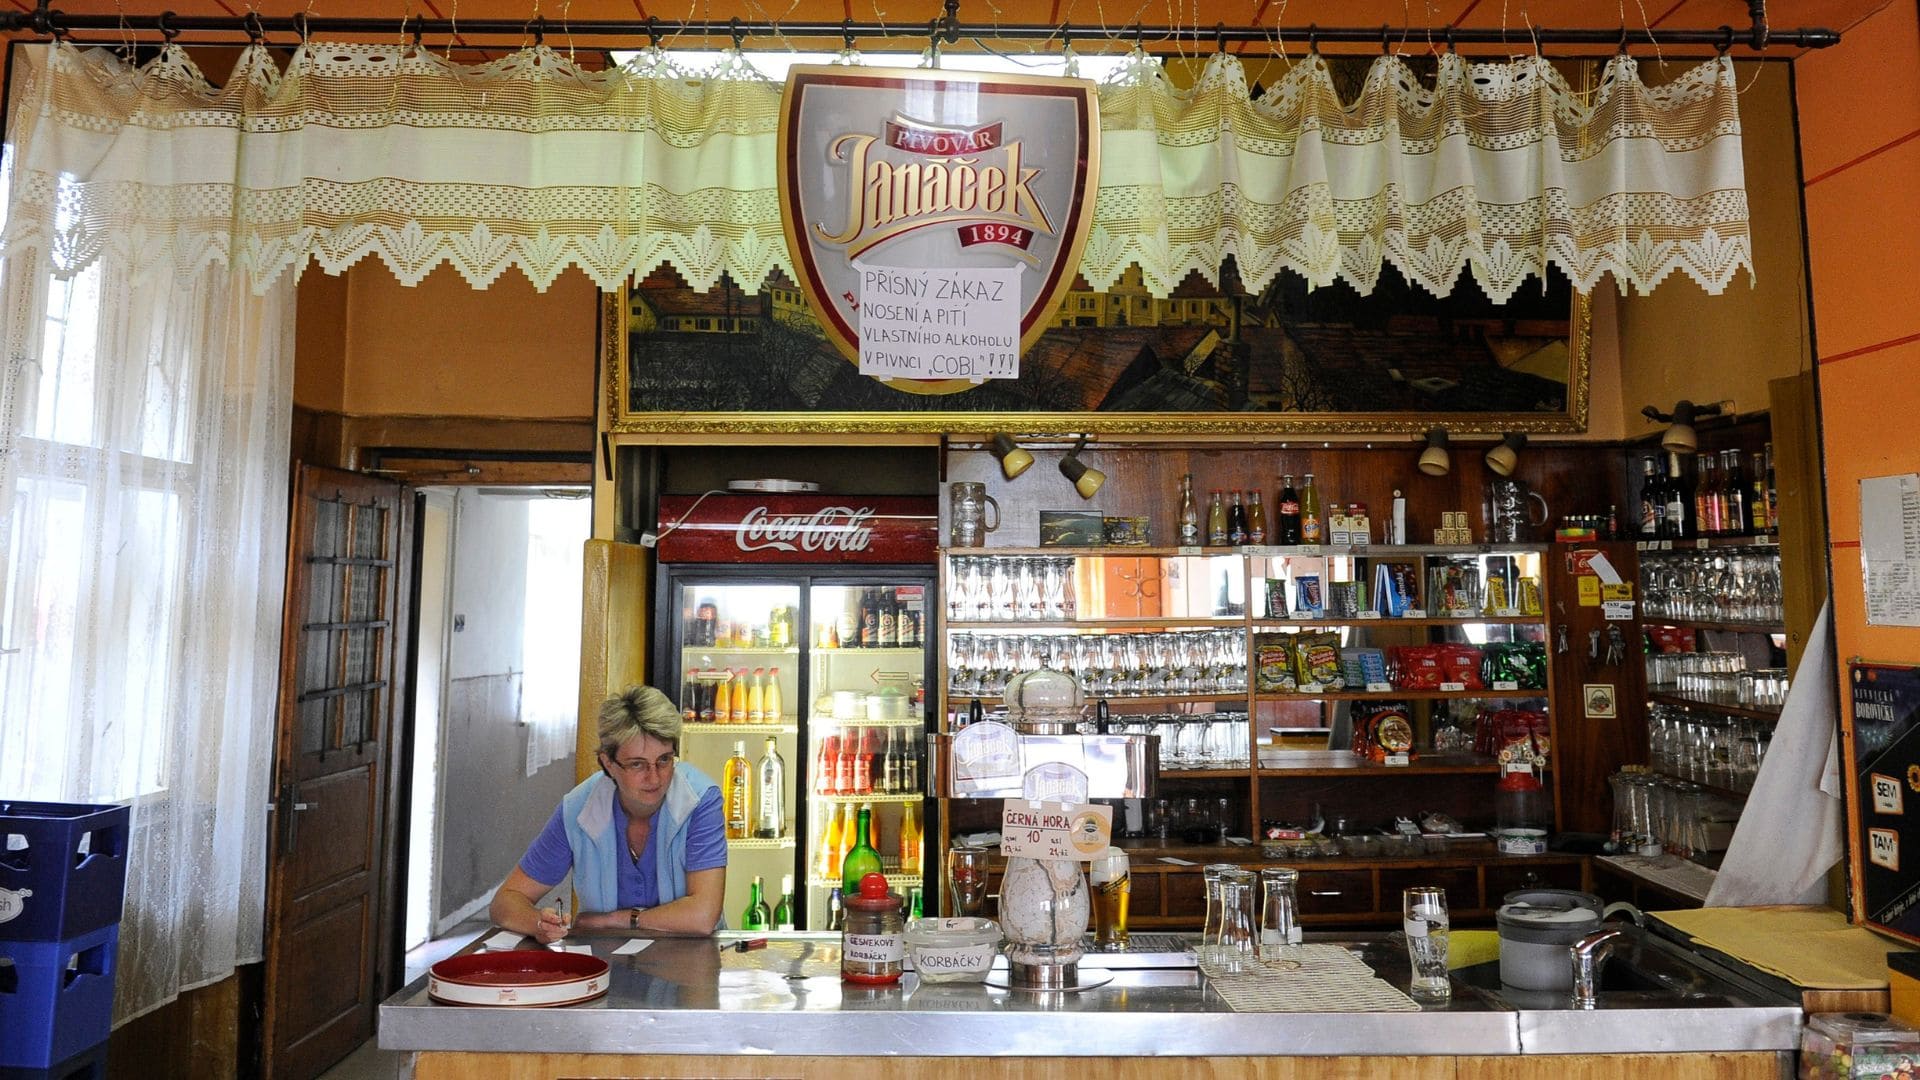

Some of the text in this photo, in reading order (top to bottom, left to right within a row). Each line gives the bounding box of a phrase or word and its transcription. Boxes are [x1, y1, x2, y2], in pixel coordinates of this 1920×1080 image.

[896, 130, 994, 153] PIVOVAR
[814, 133, 1057, 245] Janáček
[971, 226, 1024, 245] 1894
[865, 270, 1004, 301] PŘÍSNÝ ZÁKAZ
[863, 301, 920, 323] NOSENÍ
[922, 309, 933, 324] A
[864, 326, 1013, 348] VLASTNÍHO ALKOHOLU
[864, 351, 873, 365] V
[875, 351, 922, 370] PIVNCI
[735, 506, 876, 552] Coca-Cola
[1876, 781, 1897, 799] SEM
[1006, 809, 1071, 829] ČERNÁ HORA
[1872, 833, 1894, 852] TAM
[919, 952, 983, 968] KORBÁČKY
